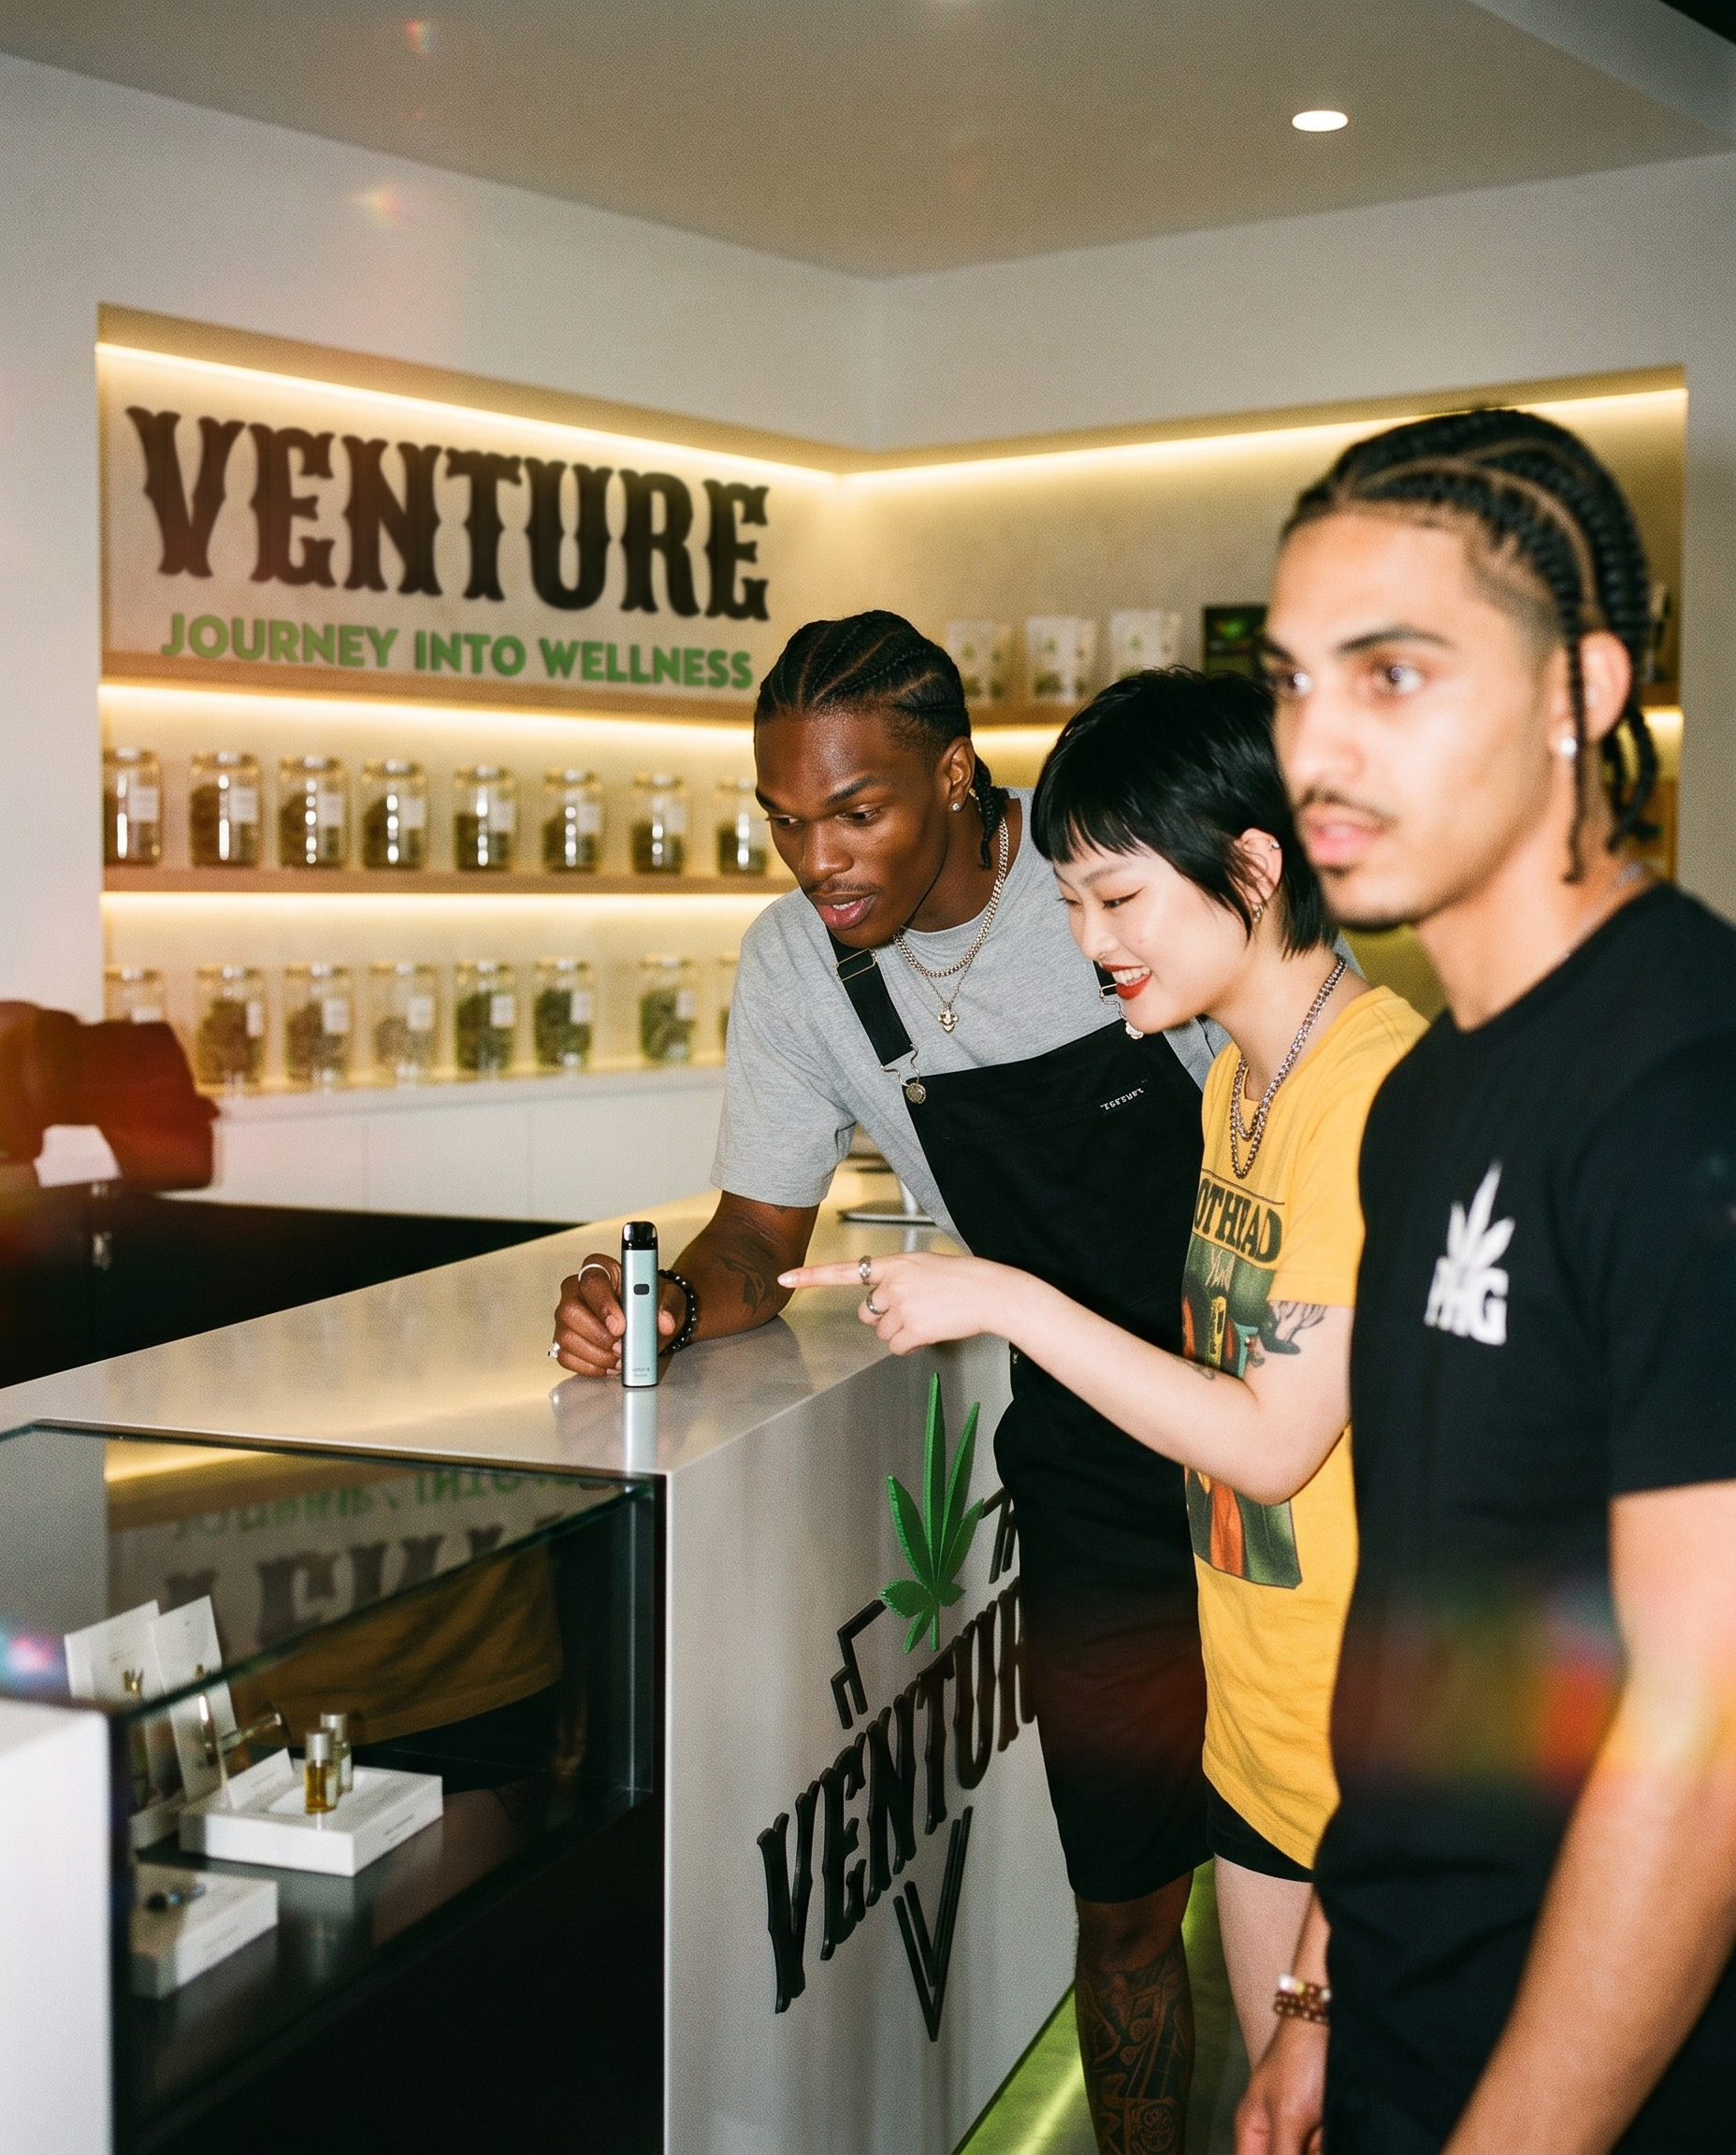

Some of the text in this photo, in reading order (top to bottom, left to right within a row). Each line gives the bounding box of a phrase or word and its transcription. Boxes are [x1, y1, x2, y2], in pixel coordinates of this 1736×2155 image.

[125, 406, 770, 621] VENTURE
[161, 613, 754, 690] JOURNEY INTO WELLNESS
[757, 1575, 1038, 2015] VENTUR
